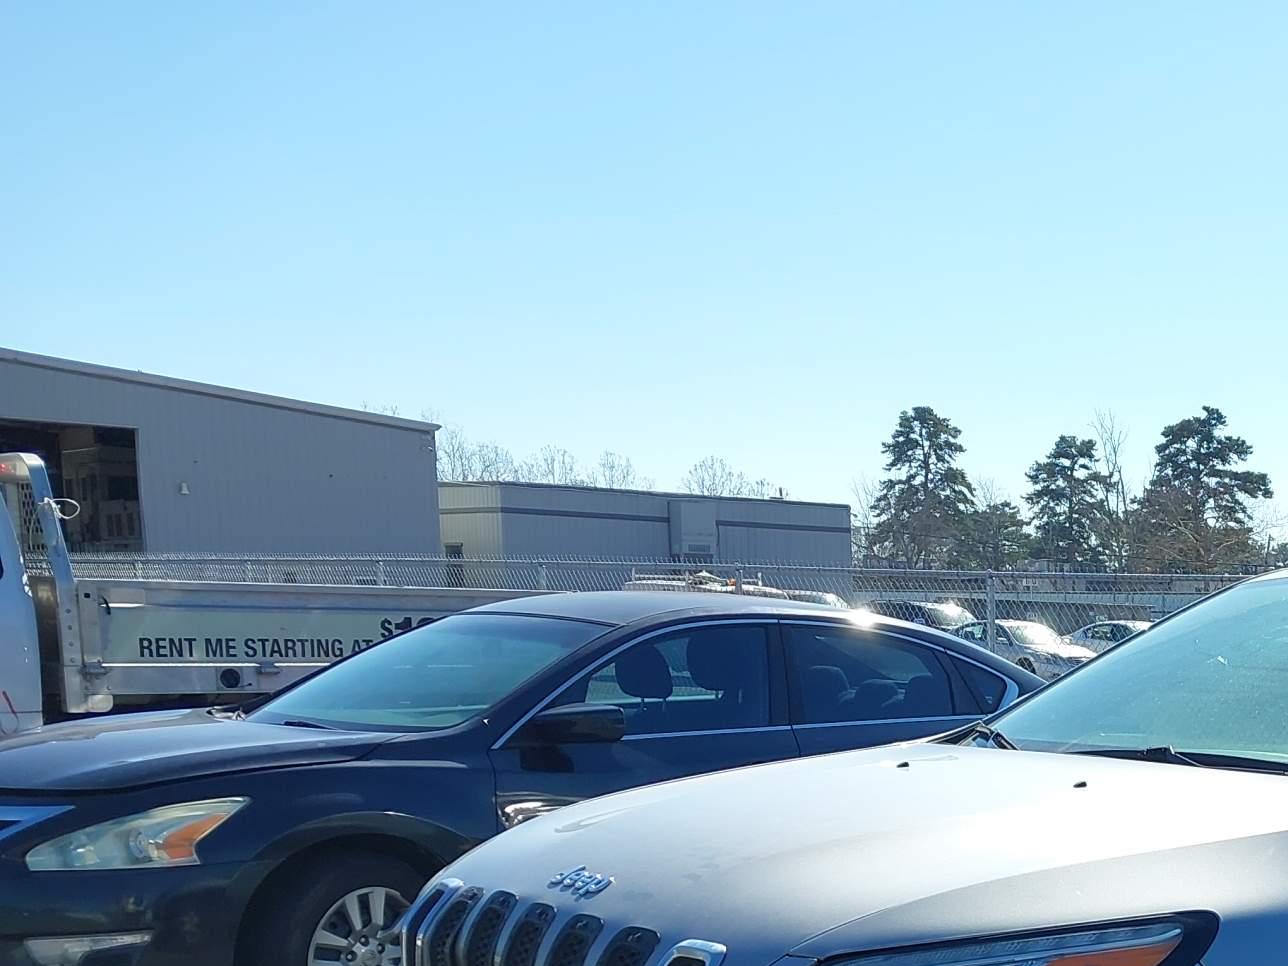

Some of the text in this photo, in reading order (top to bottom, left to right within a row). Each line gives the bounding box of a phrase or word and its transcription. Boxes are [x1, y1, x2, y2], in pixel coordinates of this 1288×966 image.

[138, 637, 197, 658] RENT
[204, 637, 237, 658] ME
[244, 638, 344, 659] STARTING
[547, 864, 616, 902] Jeep
